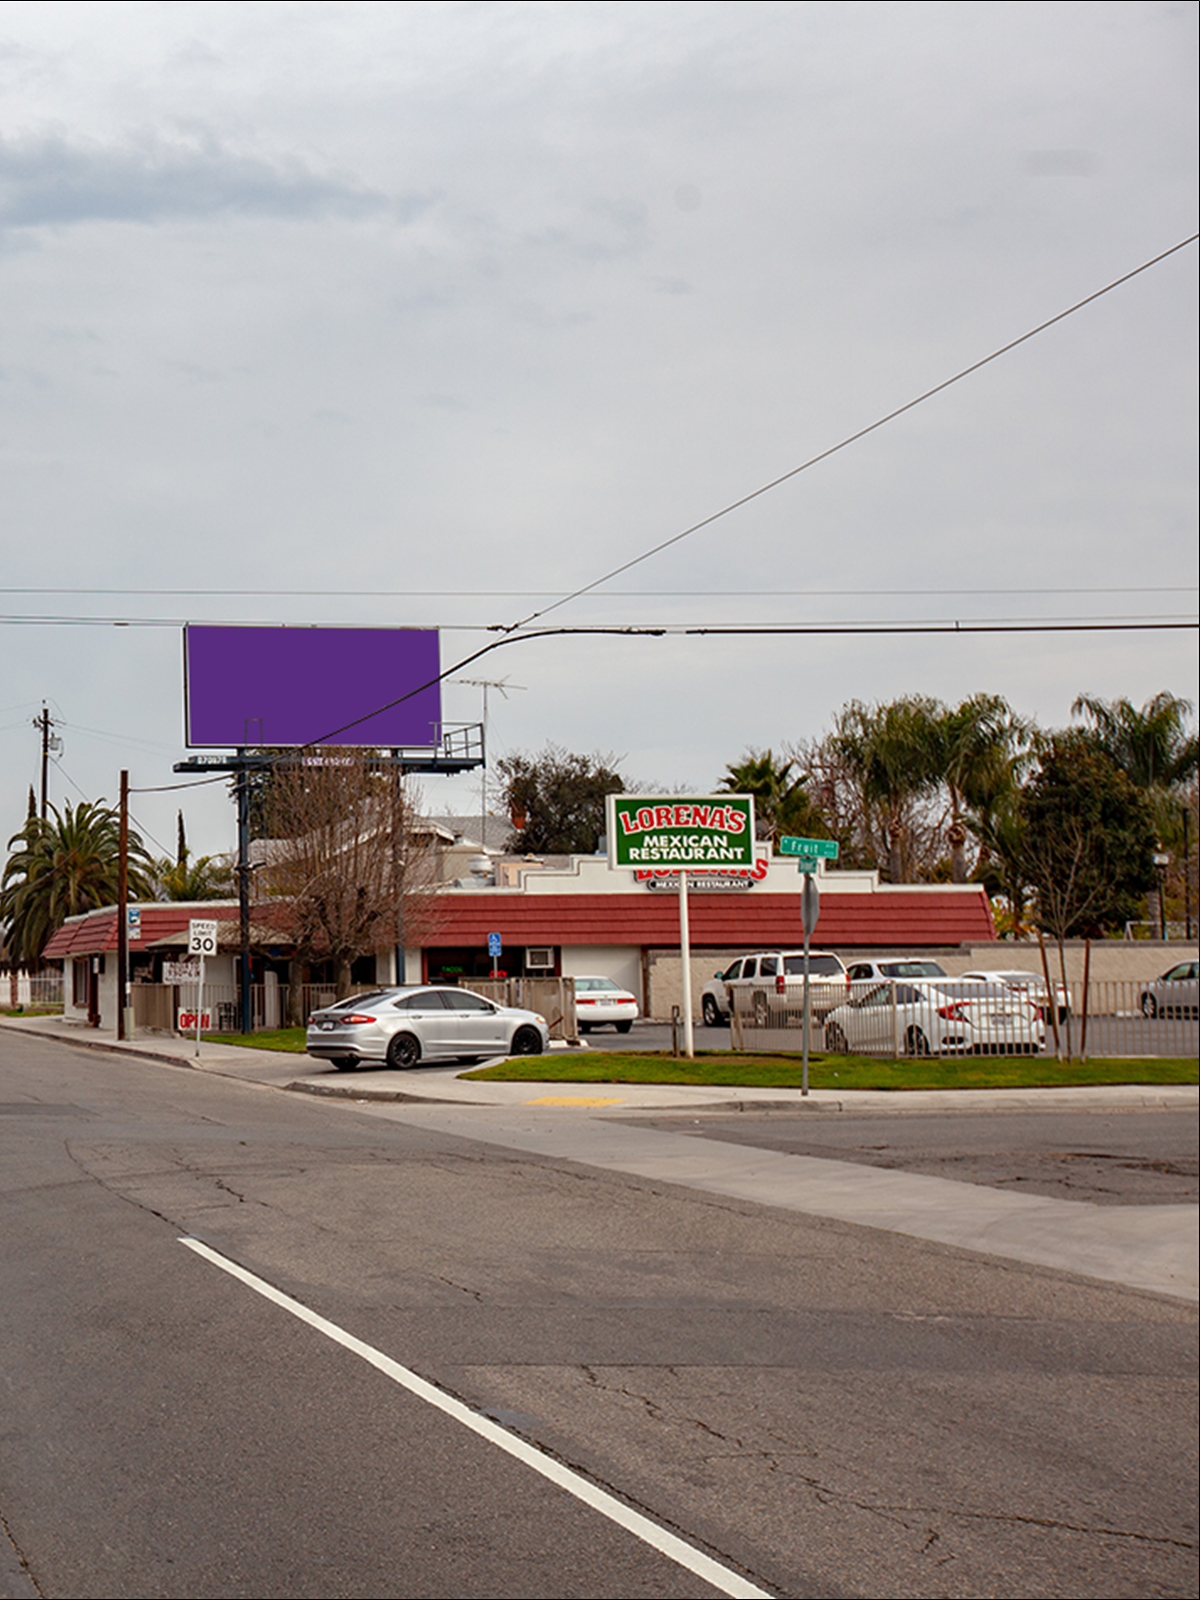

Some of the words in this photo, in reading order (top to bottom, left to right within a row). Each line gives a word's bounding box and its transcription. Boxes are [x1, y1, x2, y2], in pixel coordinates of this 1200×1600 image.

[619, 805, 746, 834] LORENA'S
[643, 835, 727, 848] MEXICAN
[629, 848, 744, 860] RESTAURANT
[655, 880, 694, 888] MEXICN
[696, 880, 748, 888] RESTAURANT
[191, 937, 214, 952] 30
